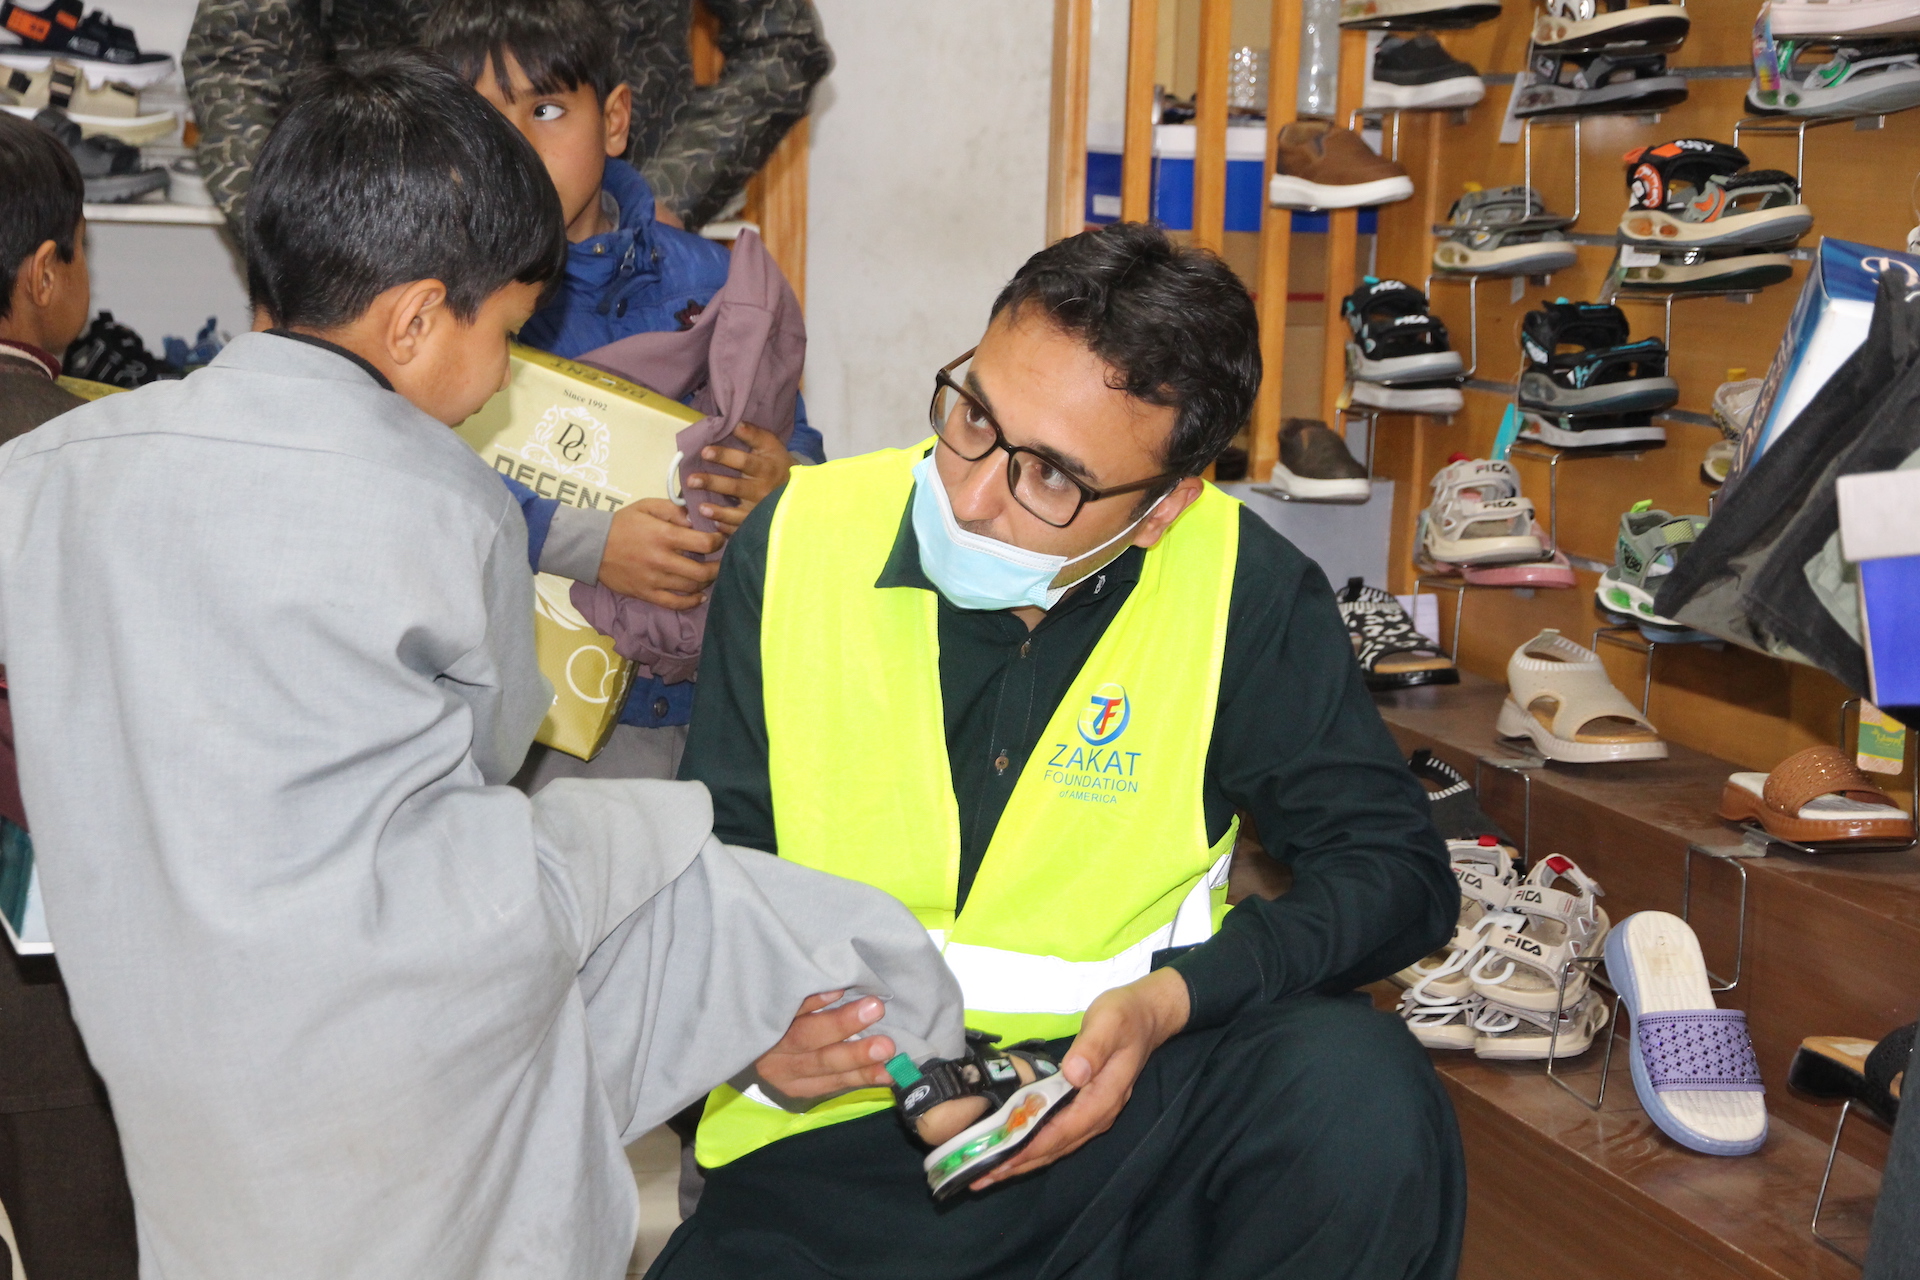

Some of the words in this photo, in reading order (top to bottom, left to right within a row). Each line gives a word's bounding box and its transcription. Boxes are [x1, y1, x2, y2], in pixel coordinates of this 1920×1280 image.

[563, 388, 587, 404] Since
[588, 398, 608, 411] 1992
[1475, 463, 1511, 475] FICA
[494, 454, 624, 512] DECENT
[1483, 500, 1518, 509] FICA
[1048, 743, 1142, 776] ZAKAT
[1044, 769, 1139, 793] FOUNDATION
[1059, 790, 1070, 798] of
[1070, 791, 1118, 804] AMERICA
[1515, 890, 1543, 903] FICA
[1504, 934, 1542, 956] FICA
